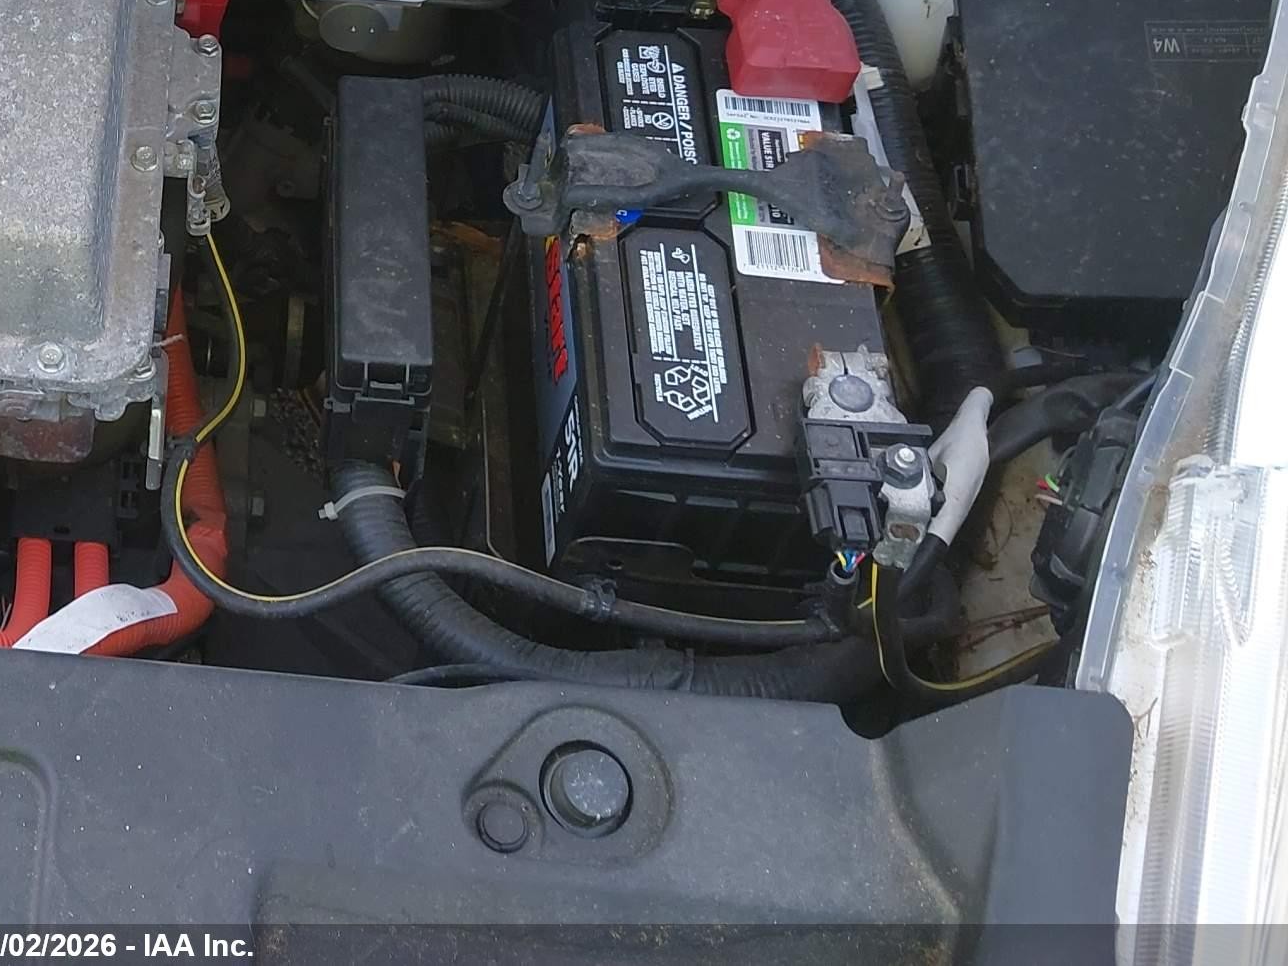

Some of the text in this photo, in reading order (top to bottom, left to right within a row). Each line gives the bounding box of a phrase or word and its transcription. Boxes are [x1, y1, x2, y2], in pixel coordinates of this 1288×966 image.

[1153, 37, 1180, 53] W4
[761, 132, 772, 154] VALUE
[690, 364, 709, 377] LEAD
[565, 409, 578, 493] 51R
